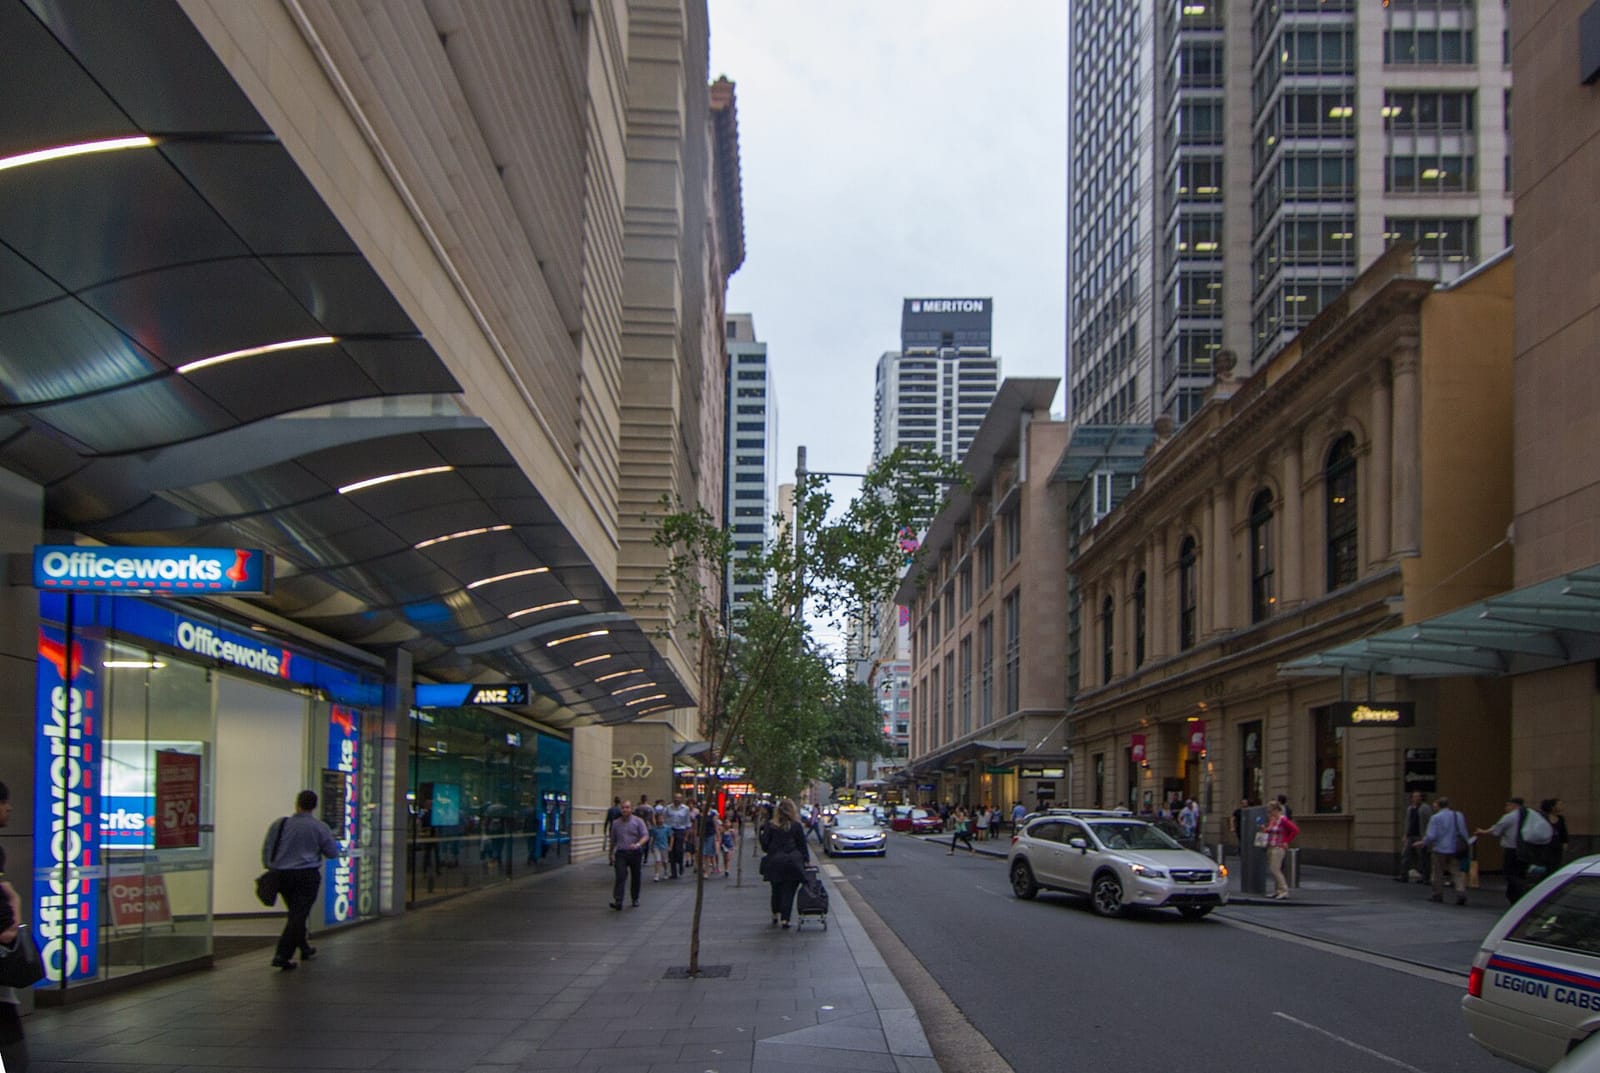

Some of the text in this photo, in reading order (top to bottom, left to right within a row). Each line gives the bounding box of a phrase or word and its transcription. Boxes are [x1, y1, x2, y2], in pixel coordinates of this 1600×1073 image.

[923, 301, 983, 312] MERITON
[42, 552, 222, 580] Officeworks
[177, 621, 280, 675] Officeworks
[473, 690, 508, 703] ANZ
[163, 800, 197, 829] 5%
[40, 685, 83, 982] Officeworks
[112, 883, 165, 900] Open
[120, 901, 161, 914] now
[1494, 973, 1600, 1011] LEGION CABS
